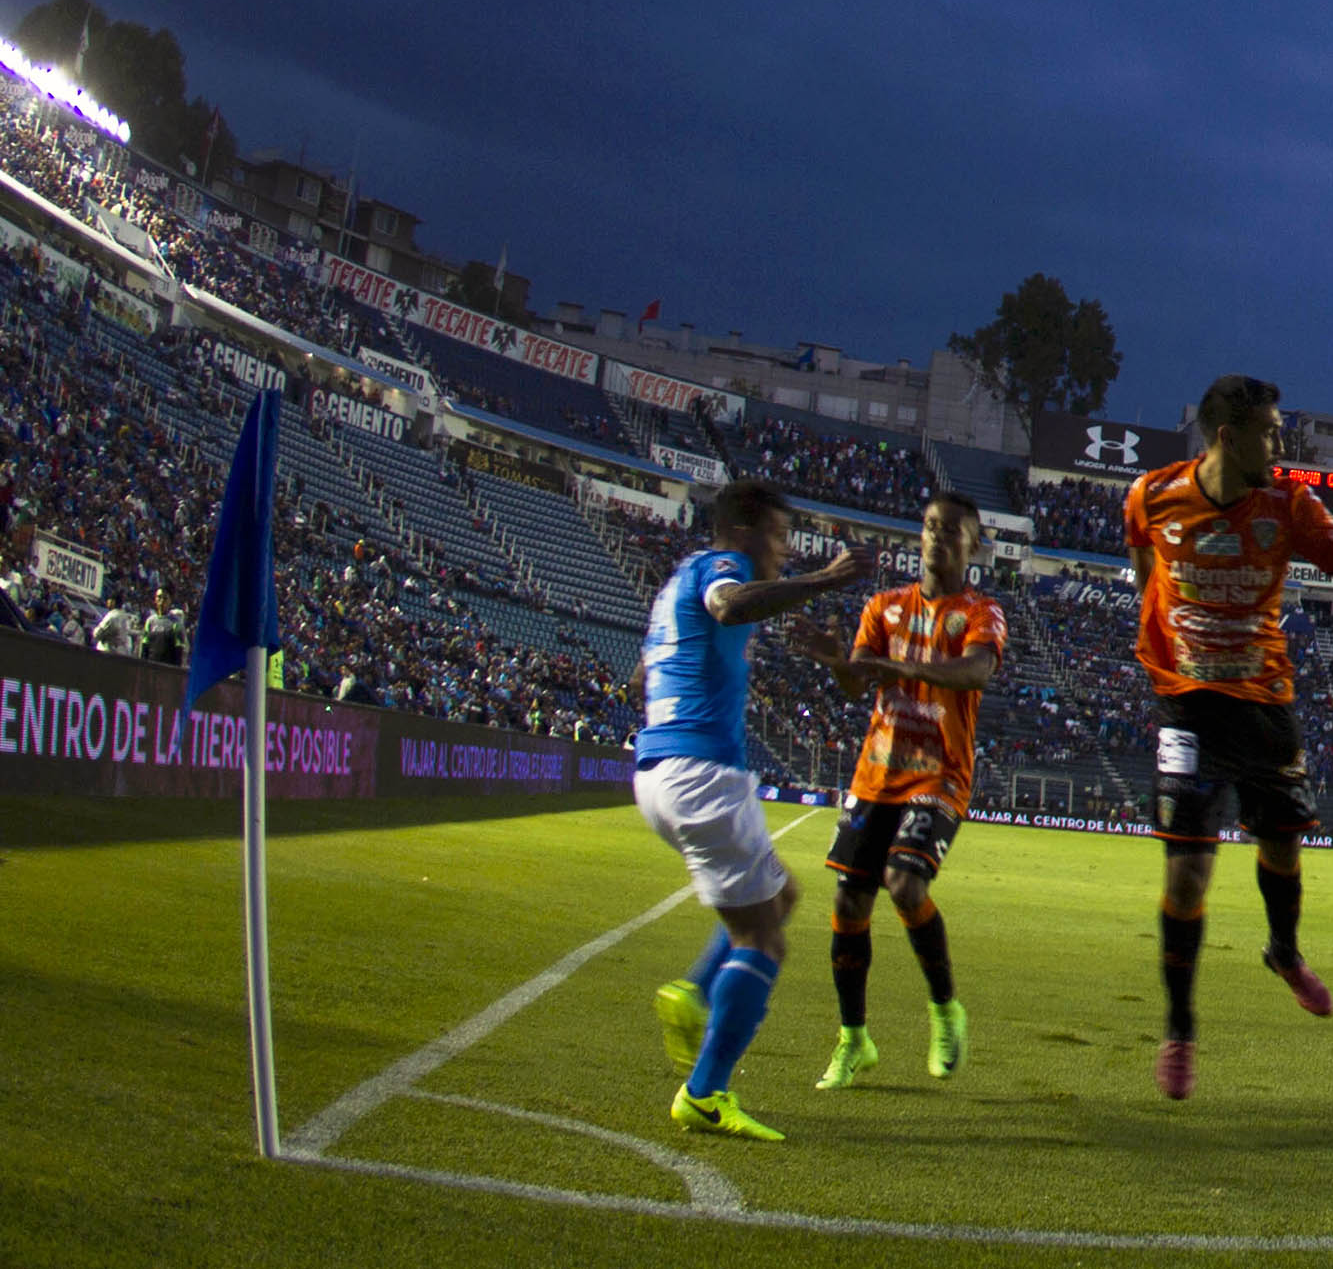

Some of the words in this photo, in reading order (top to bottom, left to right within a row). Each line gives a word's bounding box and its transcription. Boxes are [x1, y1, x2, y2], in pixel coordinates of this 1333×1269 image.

[328, 257, 396, 310] TECATE
[424, 297, 495, 346] TECATE
[376, 361, 425, 390] CEMENTO
[522, 334, 594, 380] TECATE
[328, 393, 404, 441] CEMENTO
[1074, 459, 1106, 471] UNDER
[1107, 464, 1148, 476] ARMOUR
[111, 698, 149, 764] DE
[154, 705, 182, 765] LA
[189, 710, 248, 768] TIERR
[264, 722, 287, 773] ES
[289, 726, 353, 775] POSIBLE
[401, 737, 437, 779] VIAJAR
[451, 744, 485, 779] CENTRO
[967, 808, 1014, 824] VIAJAR
[1014, 811, 1031, 825] AL
[1033, 814, 1086, 831] CENTRO
[1086, 818, 1105, 832] DE
[1107, 820, 1124, 833] LA
[1125, 822, 1153, 836] TIER
[1301, 835, 1333, 849] AJAR
